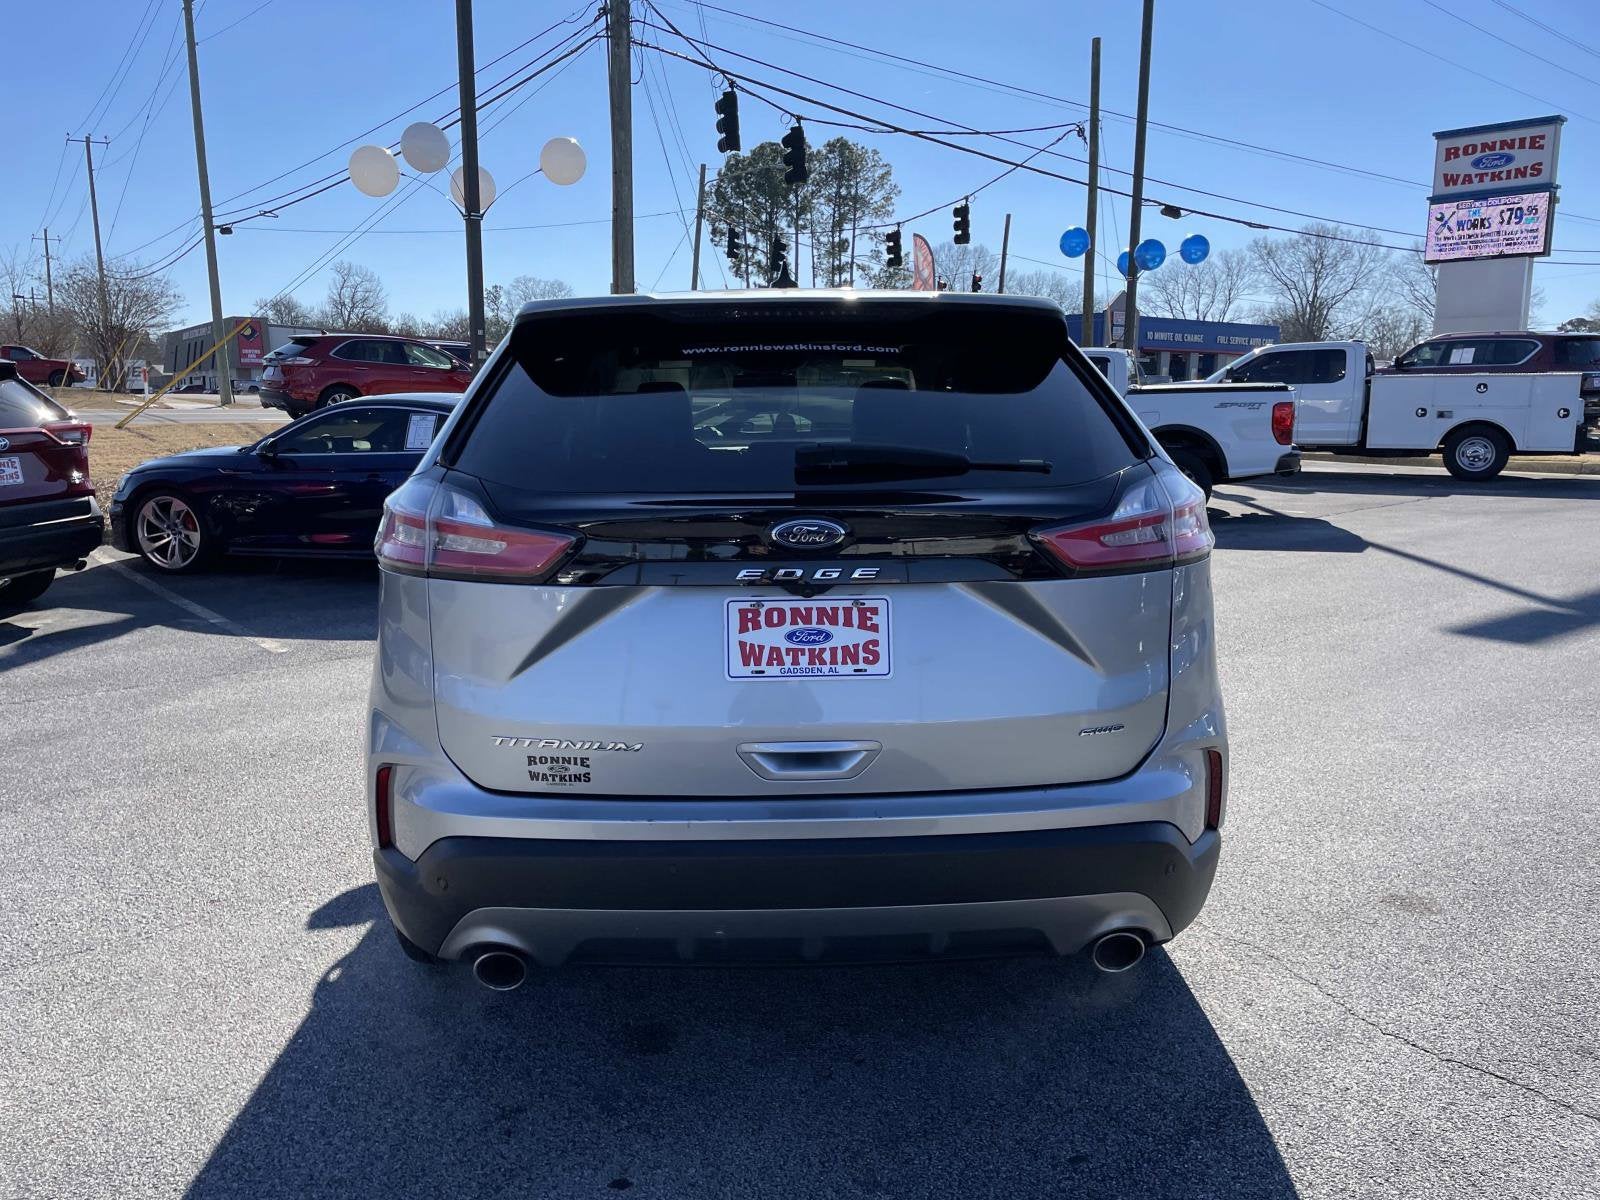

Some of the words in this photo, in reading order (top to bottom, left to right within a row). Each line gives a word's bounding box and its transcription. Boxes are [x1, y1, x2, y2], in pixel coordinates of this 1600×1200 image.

[1445, 135, 1545, 162] RONNIE
[1480, 156, 1506, 168] Ford
[1443, 162, 1543, 187] WATKINS
[1457, 200, 1487, 209] SERVICE
[1467, 208, 1482, 217] THE
[1456, 217, 1492, 232] WORKS
[1147, 331, 1154, 340] 10
[1154, 331, 1174, 341] MINUTE
[1174, 332, 1183, 341] OIL
[1183, 333, 1204, 343] CHANGE
[1216, 335, 1228, 345] FULL
[1229, 336, 1249, 346] SERVICE
[1249, 337, 1261, 346] AUTO
[1262, 338, 1274, 346] CARE
[682, 344, 900, 355] www.ronniewatkinsford.com
[788, 525, 828, 543] Ford
[735, 567, 881, 581] EDGE
[738, 606, 880, 635] RONNIE
[791, 630, 827, 643] Ford
[738, 639, 881, 667] WATKINS
[779, 666, 826, 675] GADSDEN,
[828, 666, 840, 674] AL
[490, 735, 646, 752] TITANIUM
[527, 755, 591, 769] RONNIE
[528, 769, 592, 783] WATKINS
